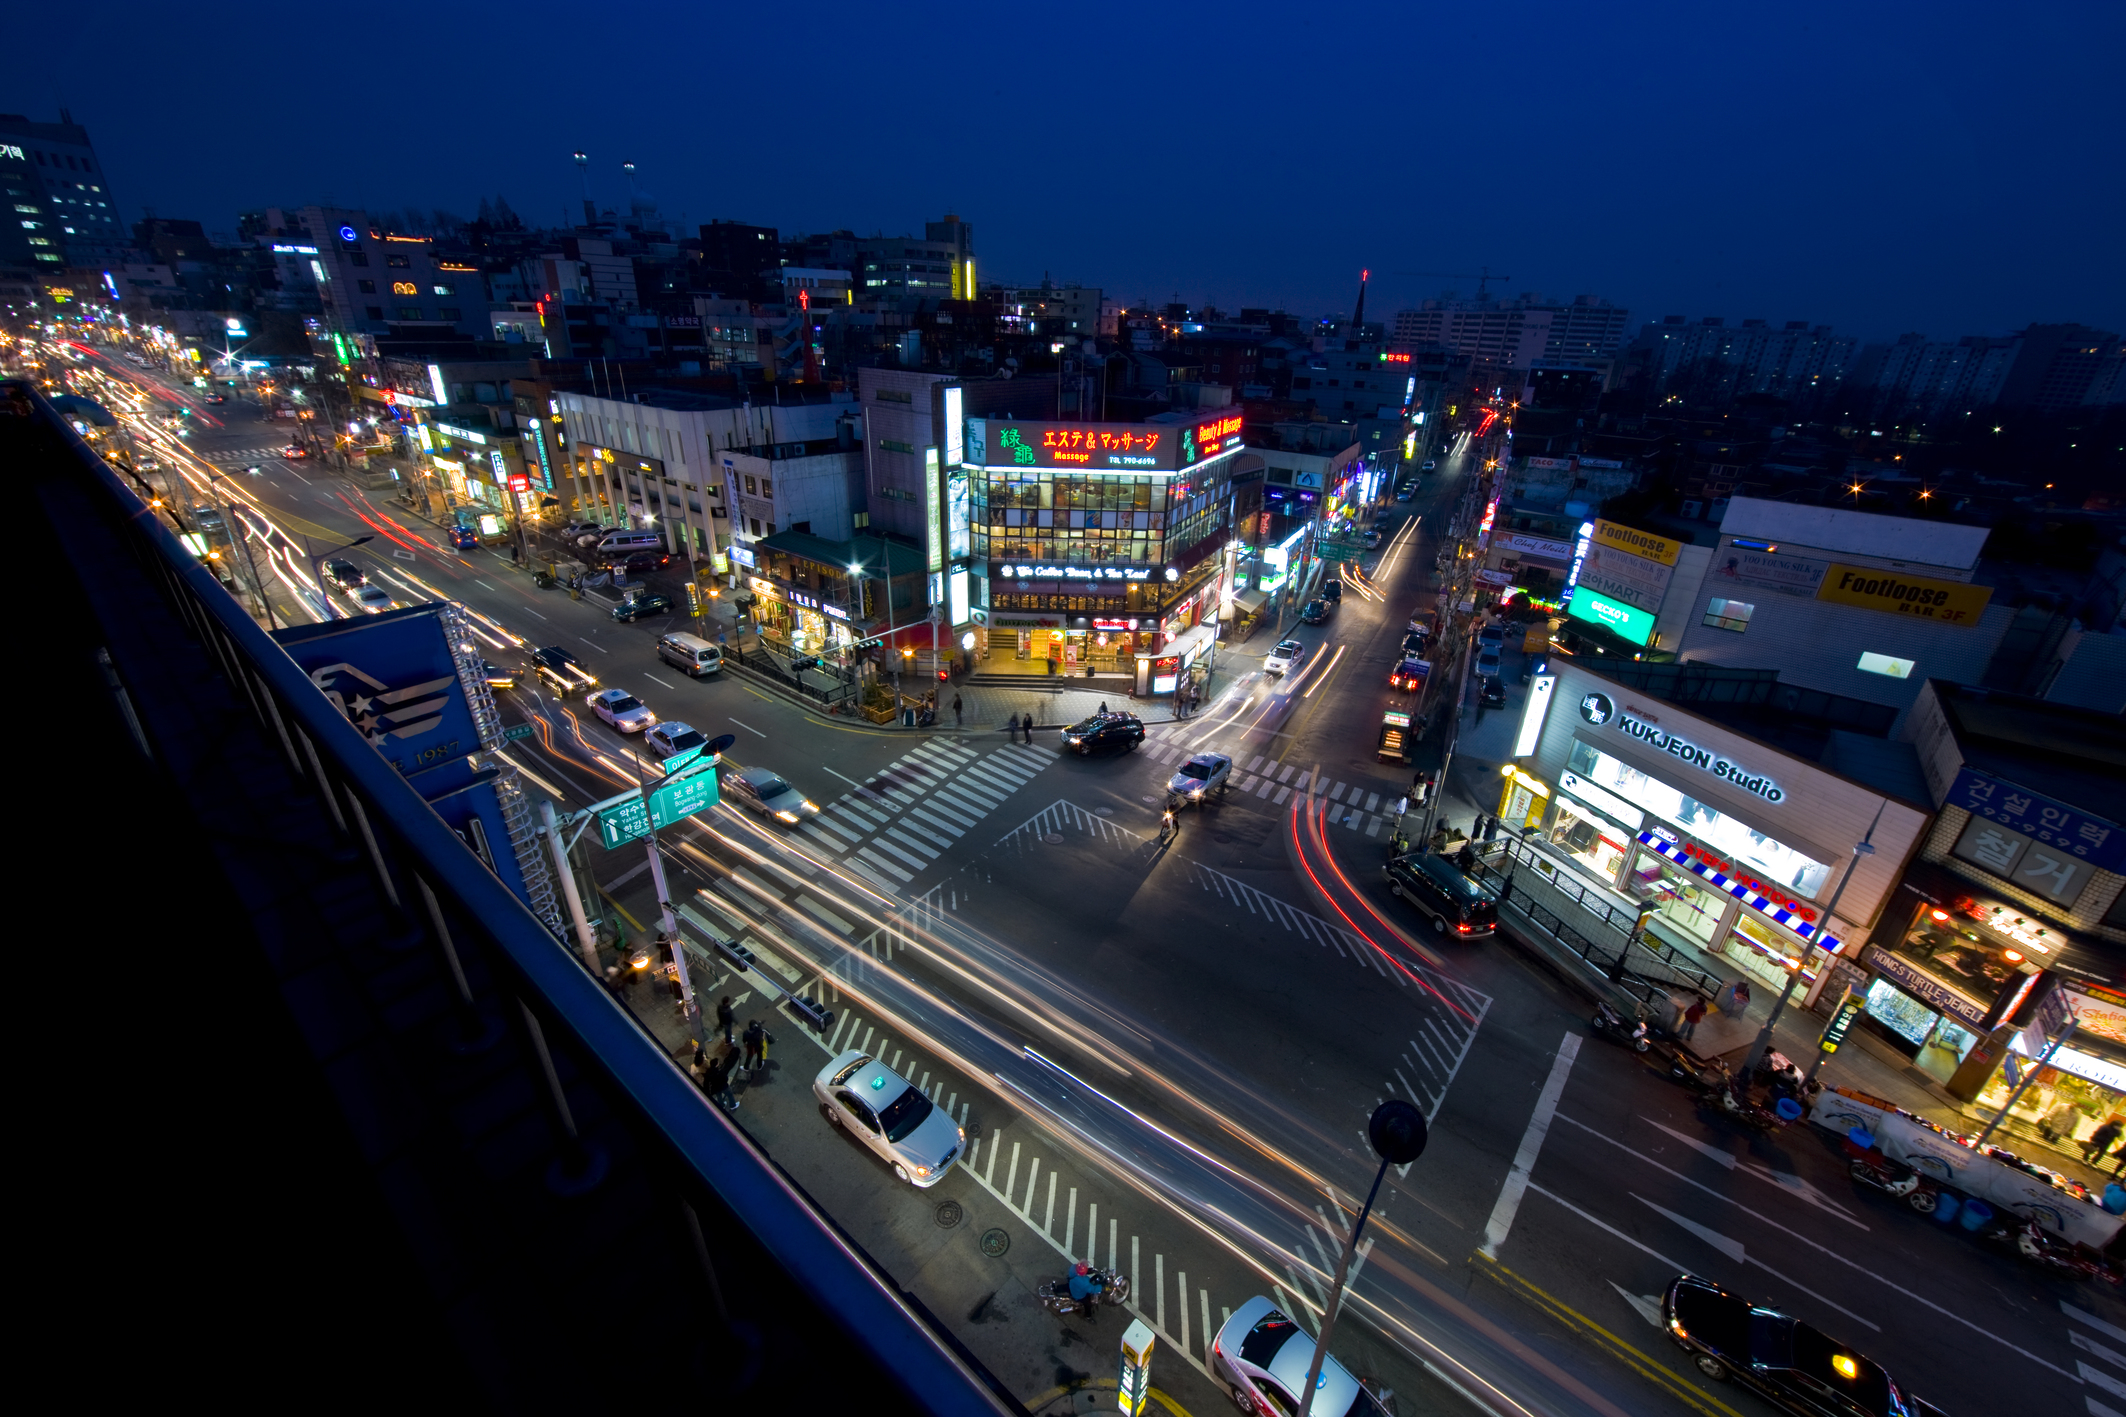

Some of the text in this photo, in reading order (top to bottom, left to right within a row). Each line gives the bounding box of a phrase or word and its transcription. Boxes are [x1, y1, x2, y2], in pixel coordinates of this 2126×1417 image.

[1043, 431, 1159, 451] エステ & マッサージ
[1198, 424, 1217, 442] Beauty
[1222, 417, 1242, 434] Massage
[535, 429, 553, 490] STARBUCKS COFFEE
[1054, 451, 1090, 462] Massage
[1514, 538, 1567, 554] Chef Meili
[1599, 522, 1665, 553] Footloose
[1604, 549, 1616, 560] YOO
[1616, 552, 1638, 567] YOUNG
[1639, 559, 1656, 573] SILK
[1641, 549, 1675, 560] BAR 3F
[803, 560, 848, 581] EPISODE
[1035, 565, 1064, 577] Coffee
[1124, 568, 1150, 580] Leaf
[1743, 555, 1823, 583] YOO YOUNG SILK 3F
[1838, 572, 1949, 607] Footloose
[994, 617, 1038, 627] Quiznos
[1591, 601, 1630, 622] GECKO'S
[1898, 603, 1966, 622] BAR 3F
[1625, 703, 1643, 718] since
[416, 741, 460, 766] 1987
[1618, 714, 1782, 803] KUKJEON Studio
[673, 780, 705, 800] 보광동
[1967, 777, 2111, 849] 건설인력
[1967, 799, 2089, 856] 793-9595
[1972, 827, 2077, 896] 철거
[1684, 842, 1818, 924] STEFF HOTDOG
[1906, 969, 1943, 1000] TURTLE
